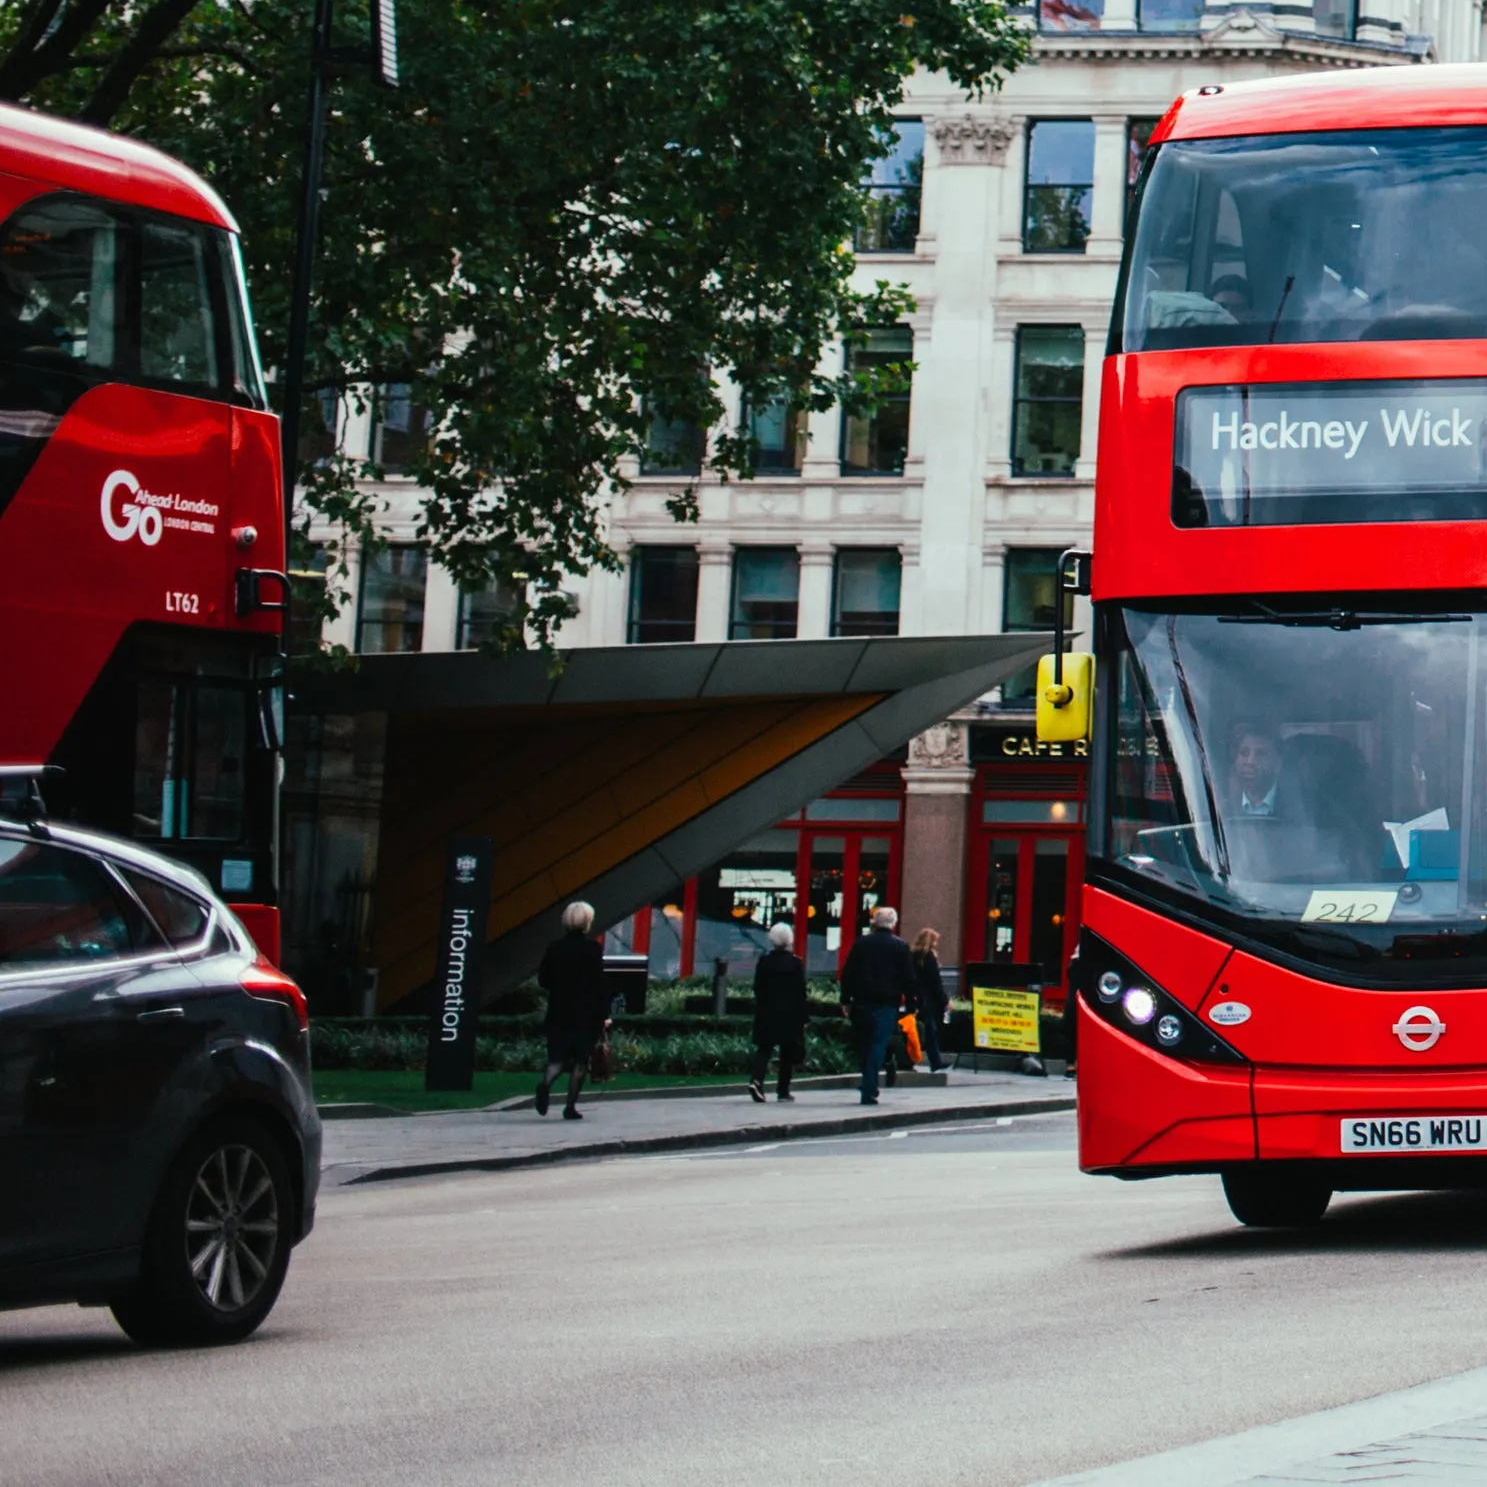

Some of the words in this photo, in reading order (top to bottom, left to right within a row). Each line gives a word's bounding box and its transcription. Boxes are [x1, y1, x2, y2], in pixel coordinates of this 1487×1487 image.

[1211, 411, 1369, 459] Hackney
[1380, 407, 1473, 448] Wick
[101, 469, 163, 546] Go
[166, 591, 200, 614] LT62
[1313, 902, 1378, 923] 242
[440, 908, 475, 1042] information
[1352, 1120, 1421, 1147] SN66
[1430, 1119, 1481, 1146] WRU
